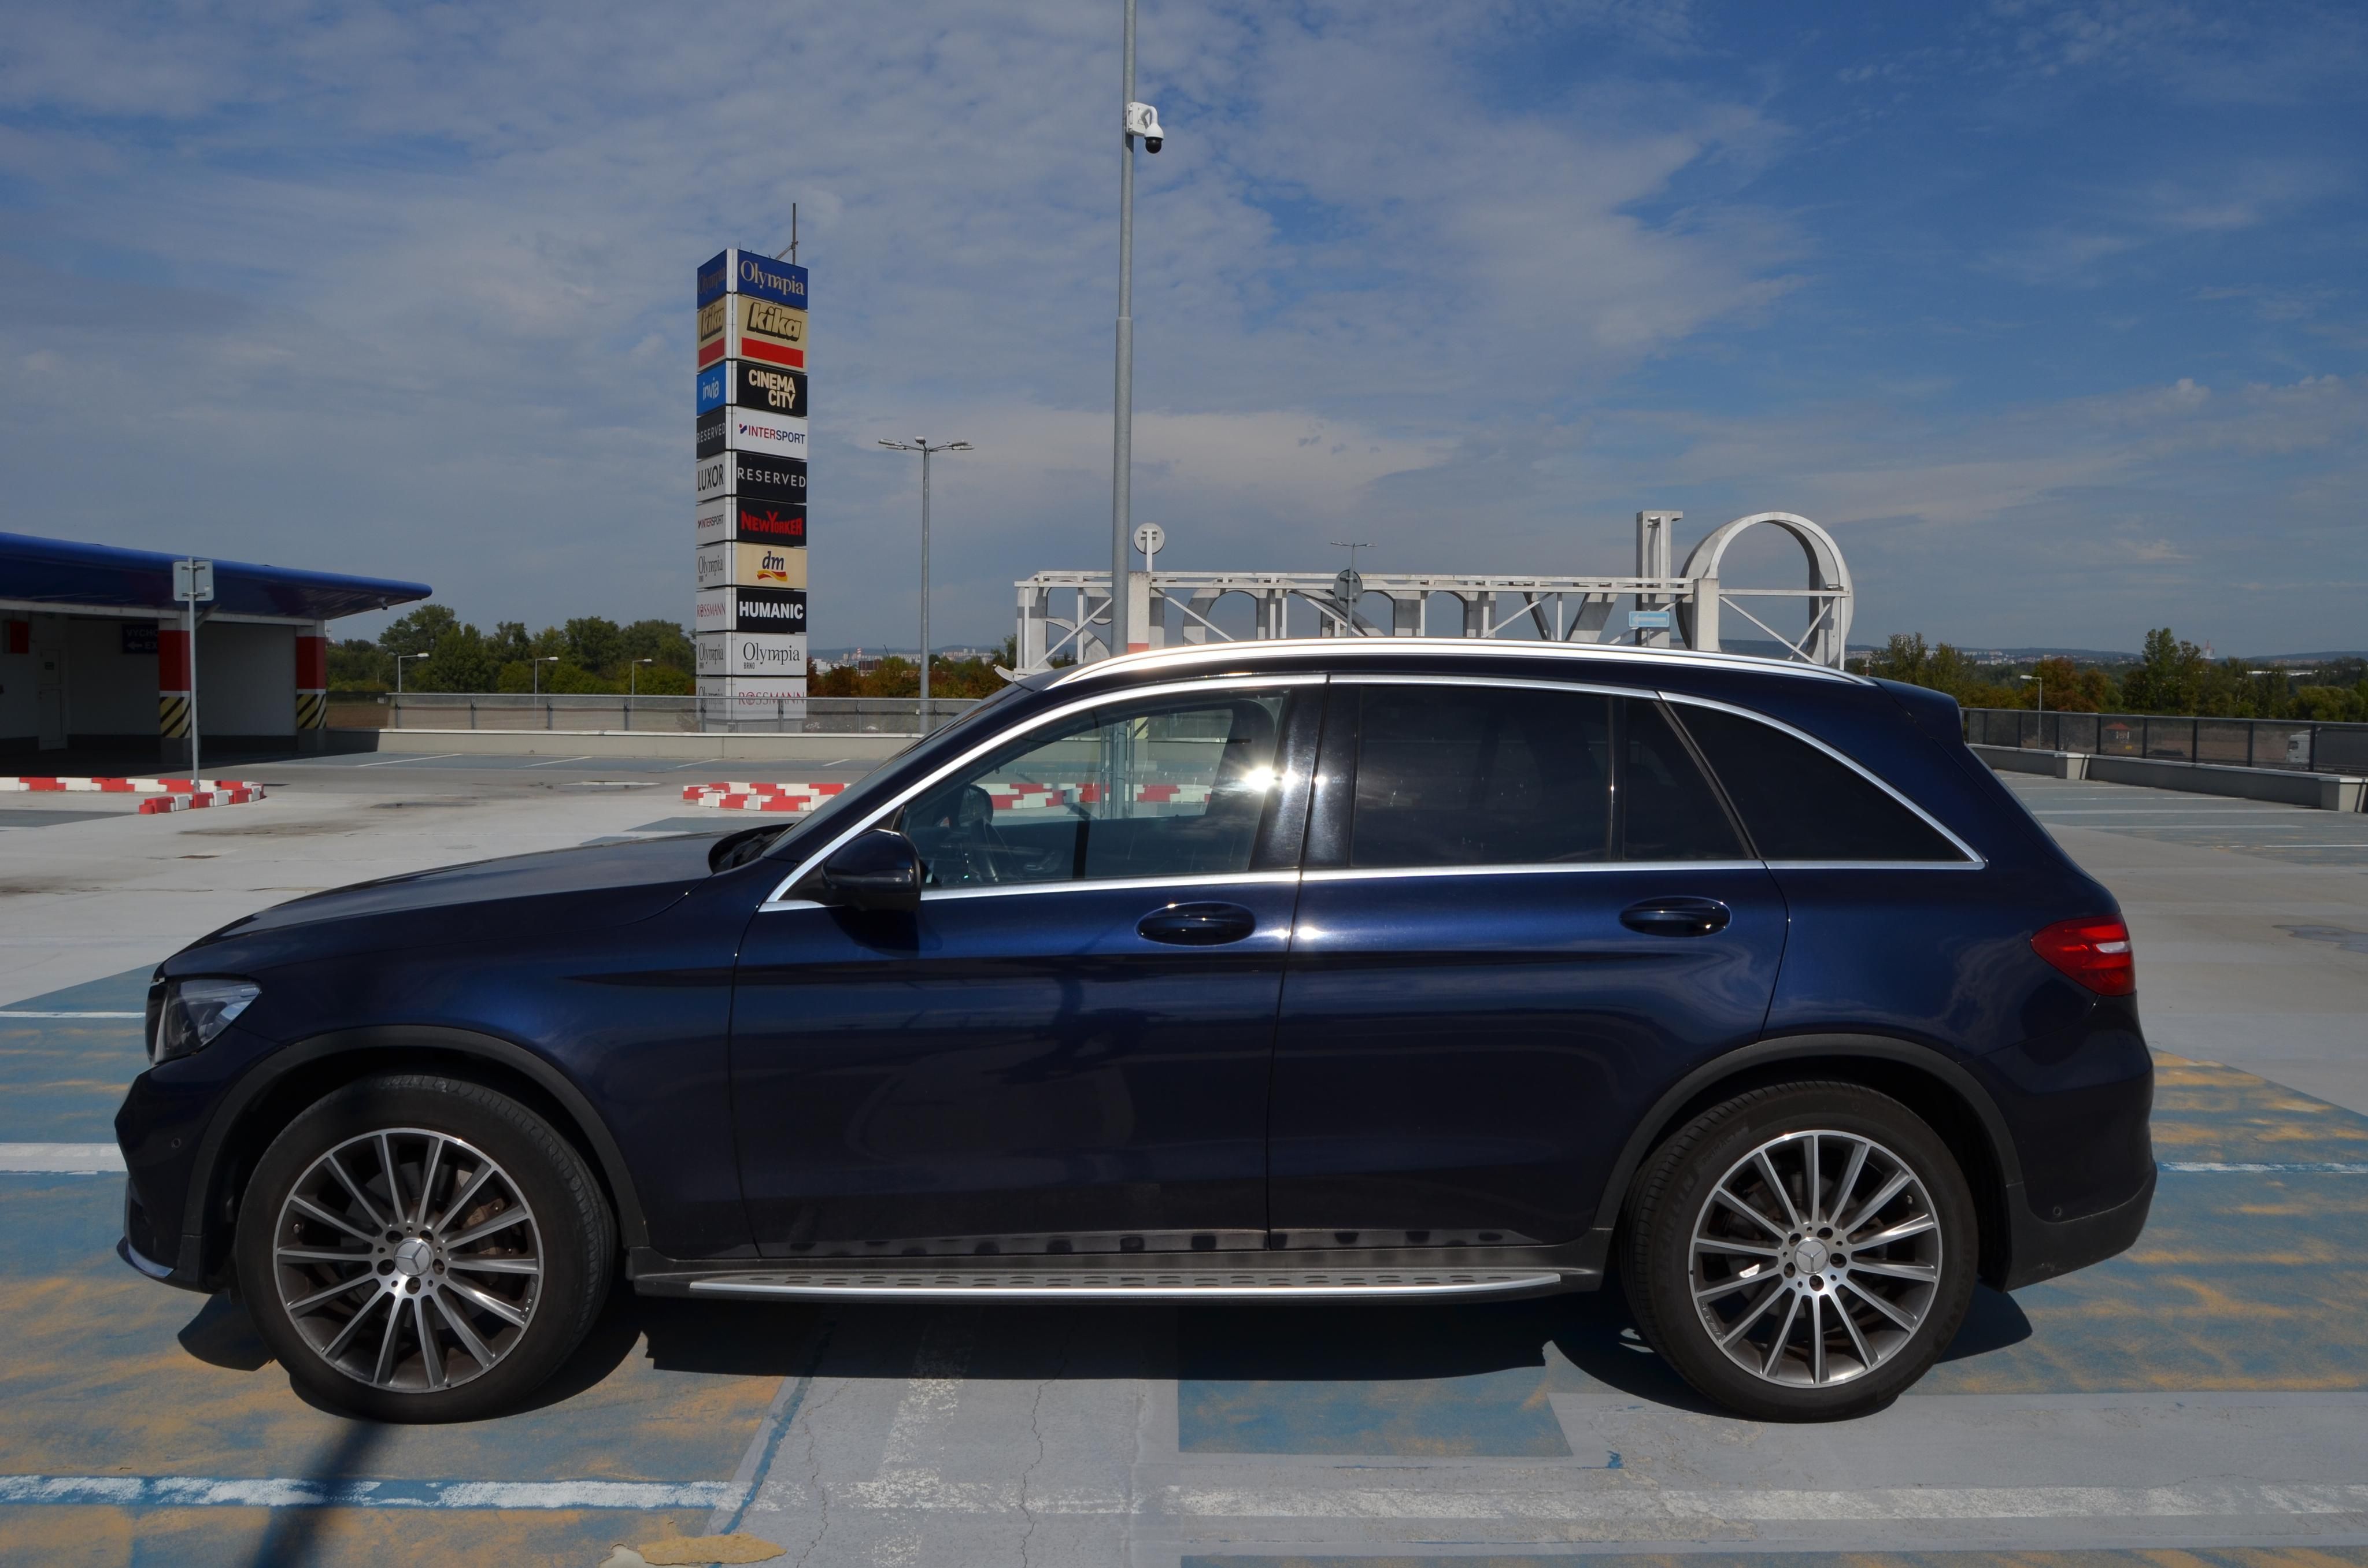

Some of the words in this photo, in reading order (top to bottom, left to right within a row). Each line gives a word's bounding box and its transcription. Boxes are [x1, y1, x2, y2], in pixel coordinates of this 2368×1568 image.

[741, 260, 805, 295] Olympia
[701, 305, 724, 342] kika
[746, 302, 802, 342] kika
[703, 377, 719, 401] invia
[749, 369, 796, 394] CINEMA
[768, 389, 796, 409] CITY
[697, 422, 726, 443] RESERVED
[748, 425, 805, 444] INTERSPORT
[698, 464, 724, 491] LUXOR
[737, 466, 806, 488] RESERVED
[698, 555, 723, 577] Olympia
[762, 550, 785, 571] dm
[697, 602, 726, 618] ROSSMANN
[739, 600, 804, 620] HUMANIC
[698, 643, 724, 665] Olympia
[743, 642, 800, 665] Olympia
[739, 691, 805, 706] ROSSMANN
